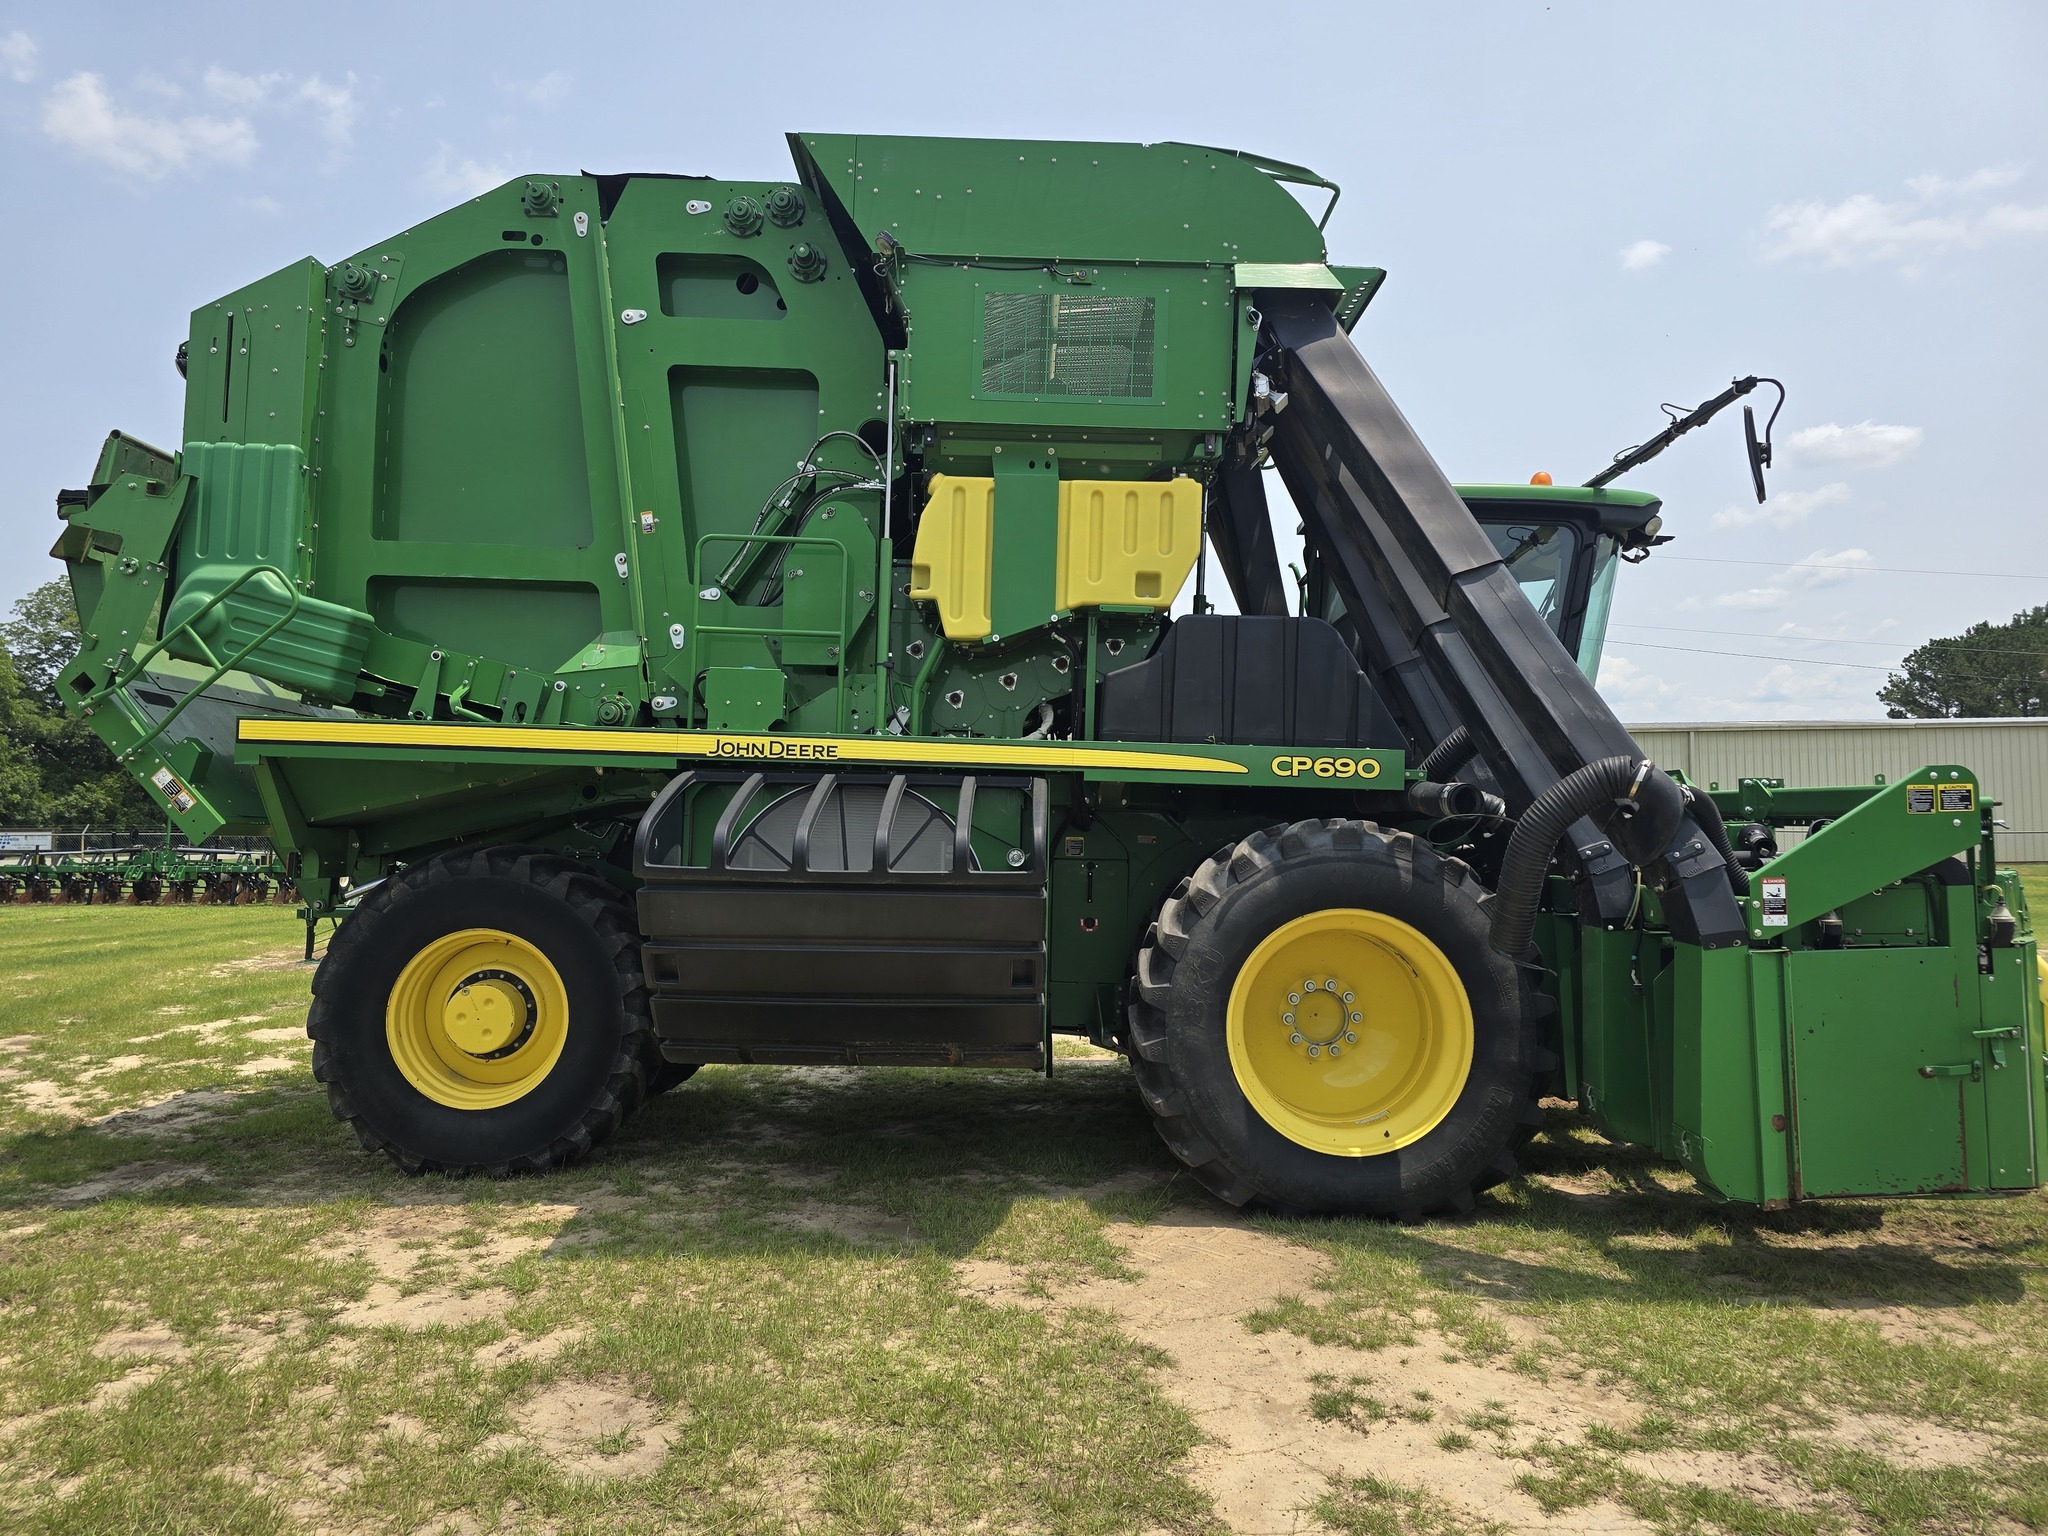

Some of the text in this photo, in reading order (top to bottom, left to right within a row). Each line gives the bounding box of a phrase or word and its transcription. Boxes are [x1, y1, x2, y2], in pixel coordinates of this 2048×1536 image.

[708, 739, 839, 758] JOHN DEERE
[1271, 755, 1381, 779] CP690
